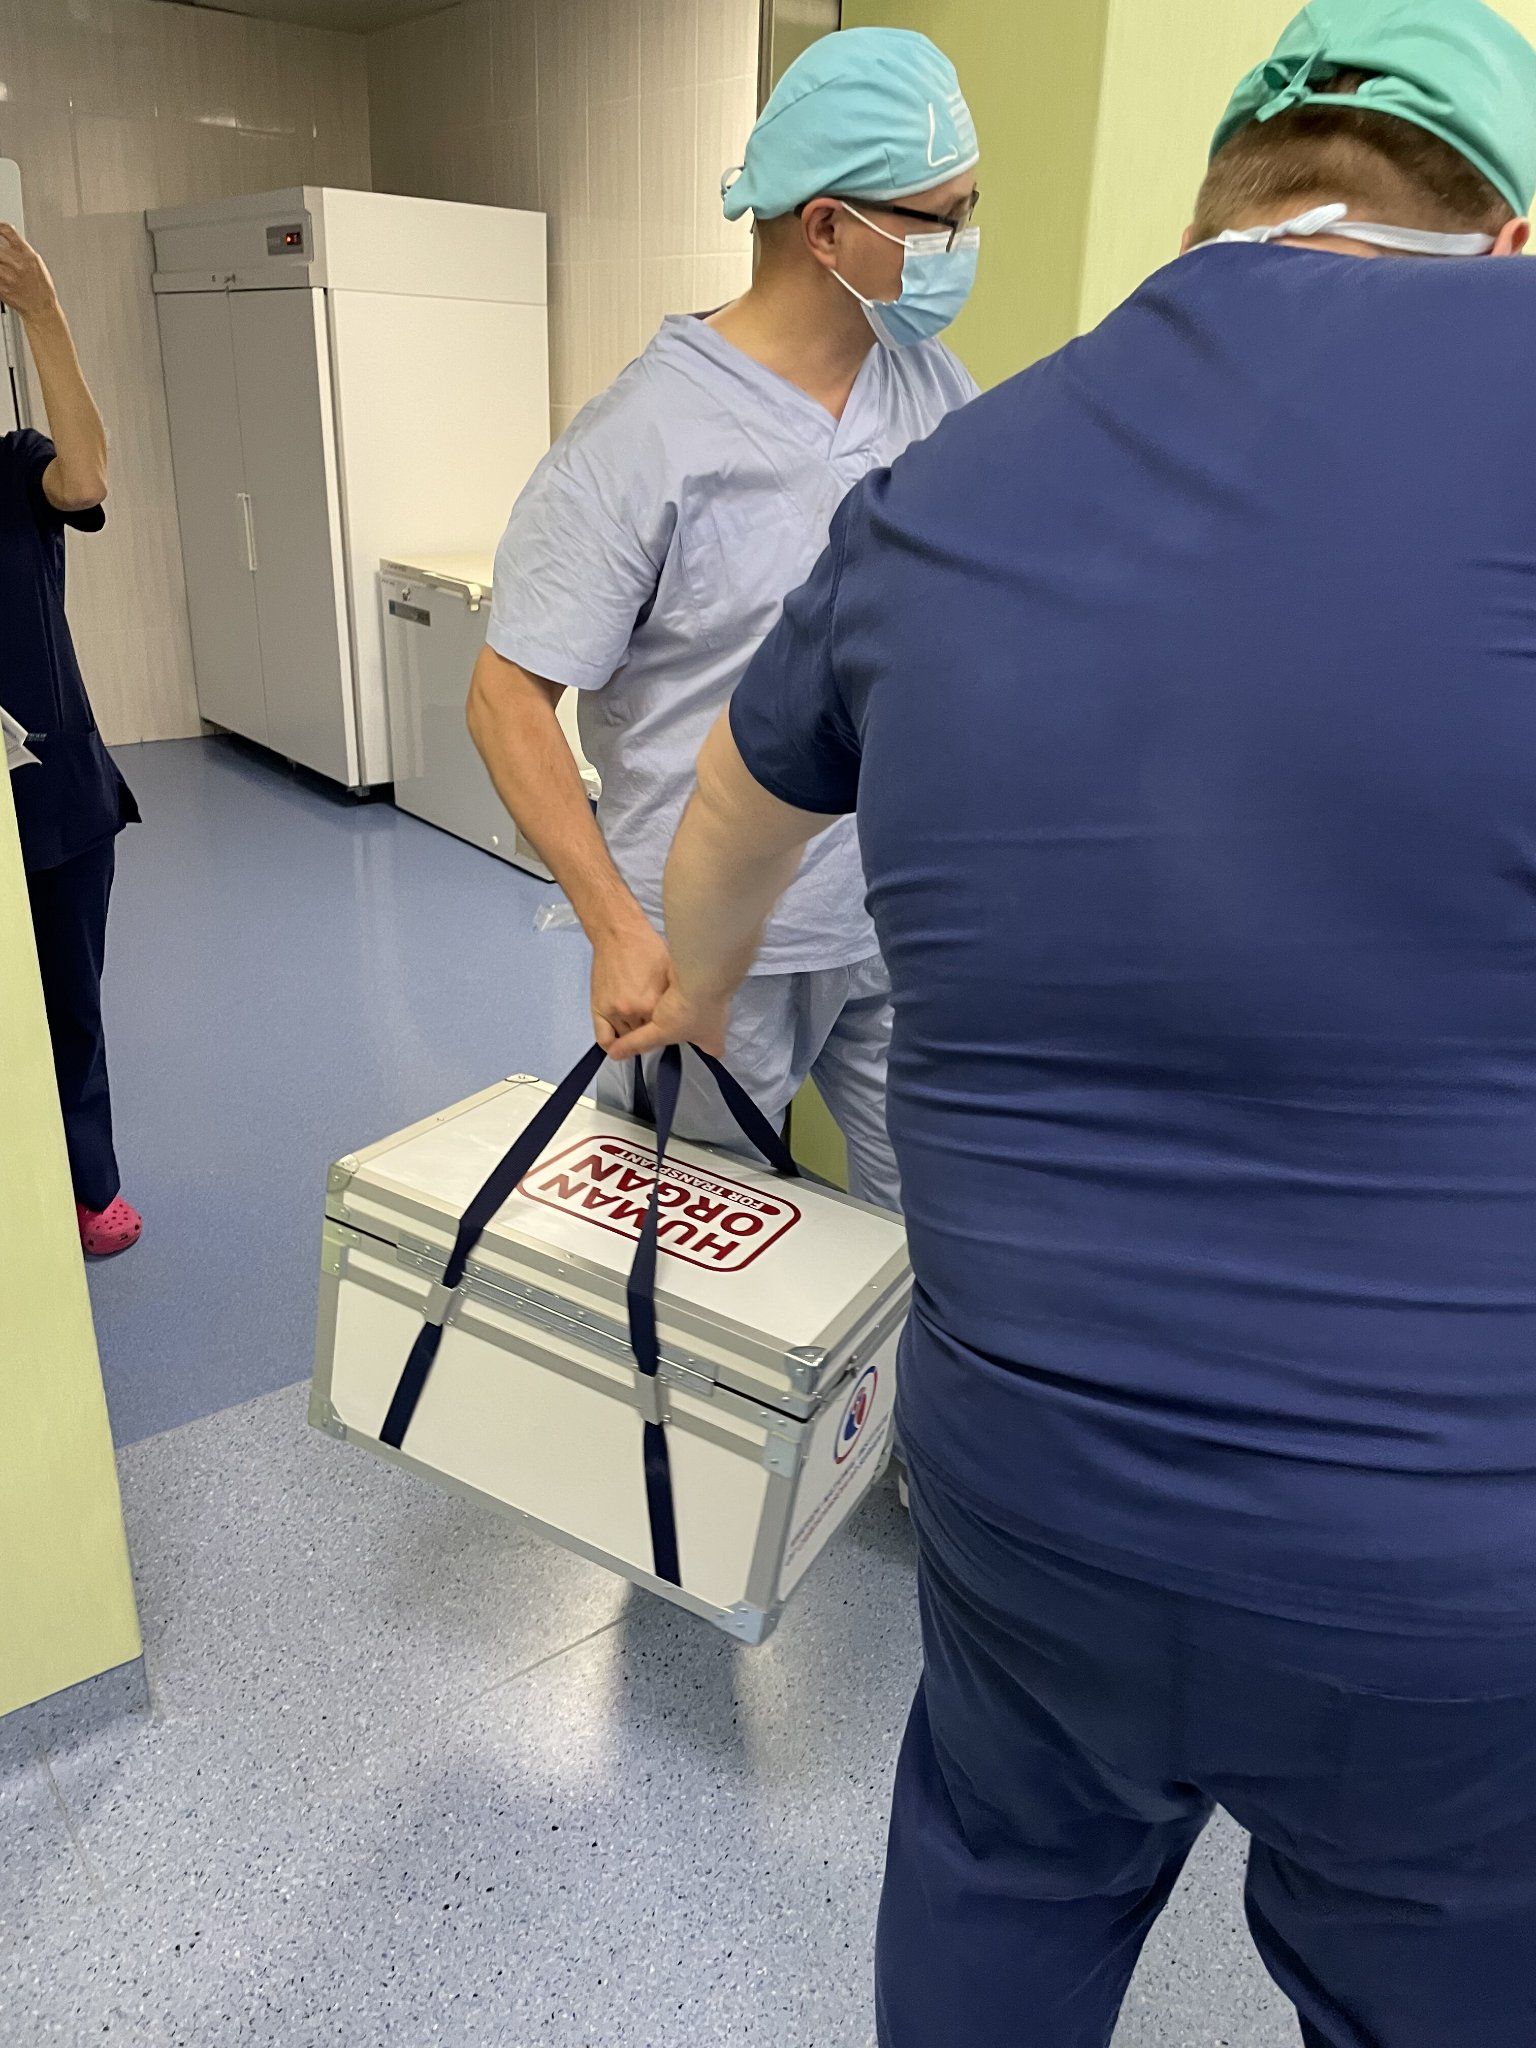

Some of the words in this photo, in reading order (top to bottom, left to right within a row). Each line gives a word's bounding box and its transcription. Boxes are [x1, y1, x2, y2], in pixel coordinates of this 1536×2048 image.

[570, 1153, 764, 1236] ORGAN
[614, 1150, 725, 1197] TRANSPLANT
[726, 1189, 764, 1210] FOR
[538, 1174, 740, 1260] HUMAN
